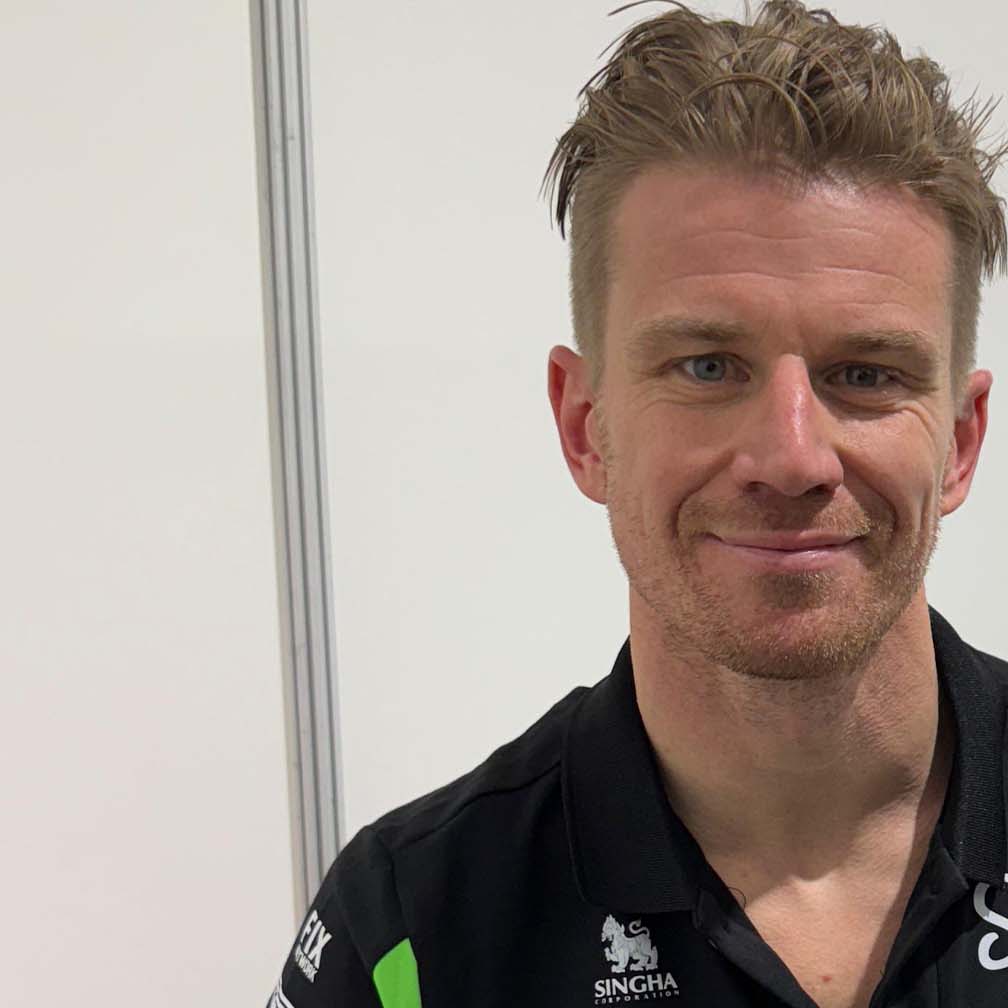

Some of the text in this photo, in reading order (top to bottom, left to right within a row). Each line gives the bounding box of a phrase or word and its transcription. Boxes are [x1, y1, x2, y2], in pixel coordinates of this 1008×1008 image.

[299, 909, 333, 970] FIX
[594, 972, 678, 998] SINGHA
[594, 989, 680, 1005] CORPORATION
